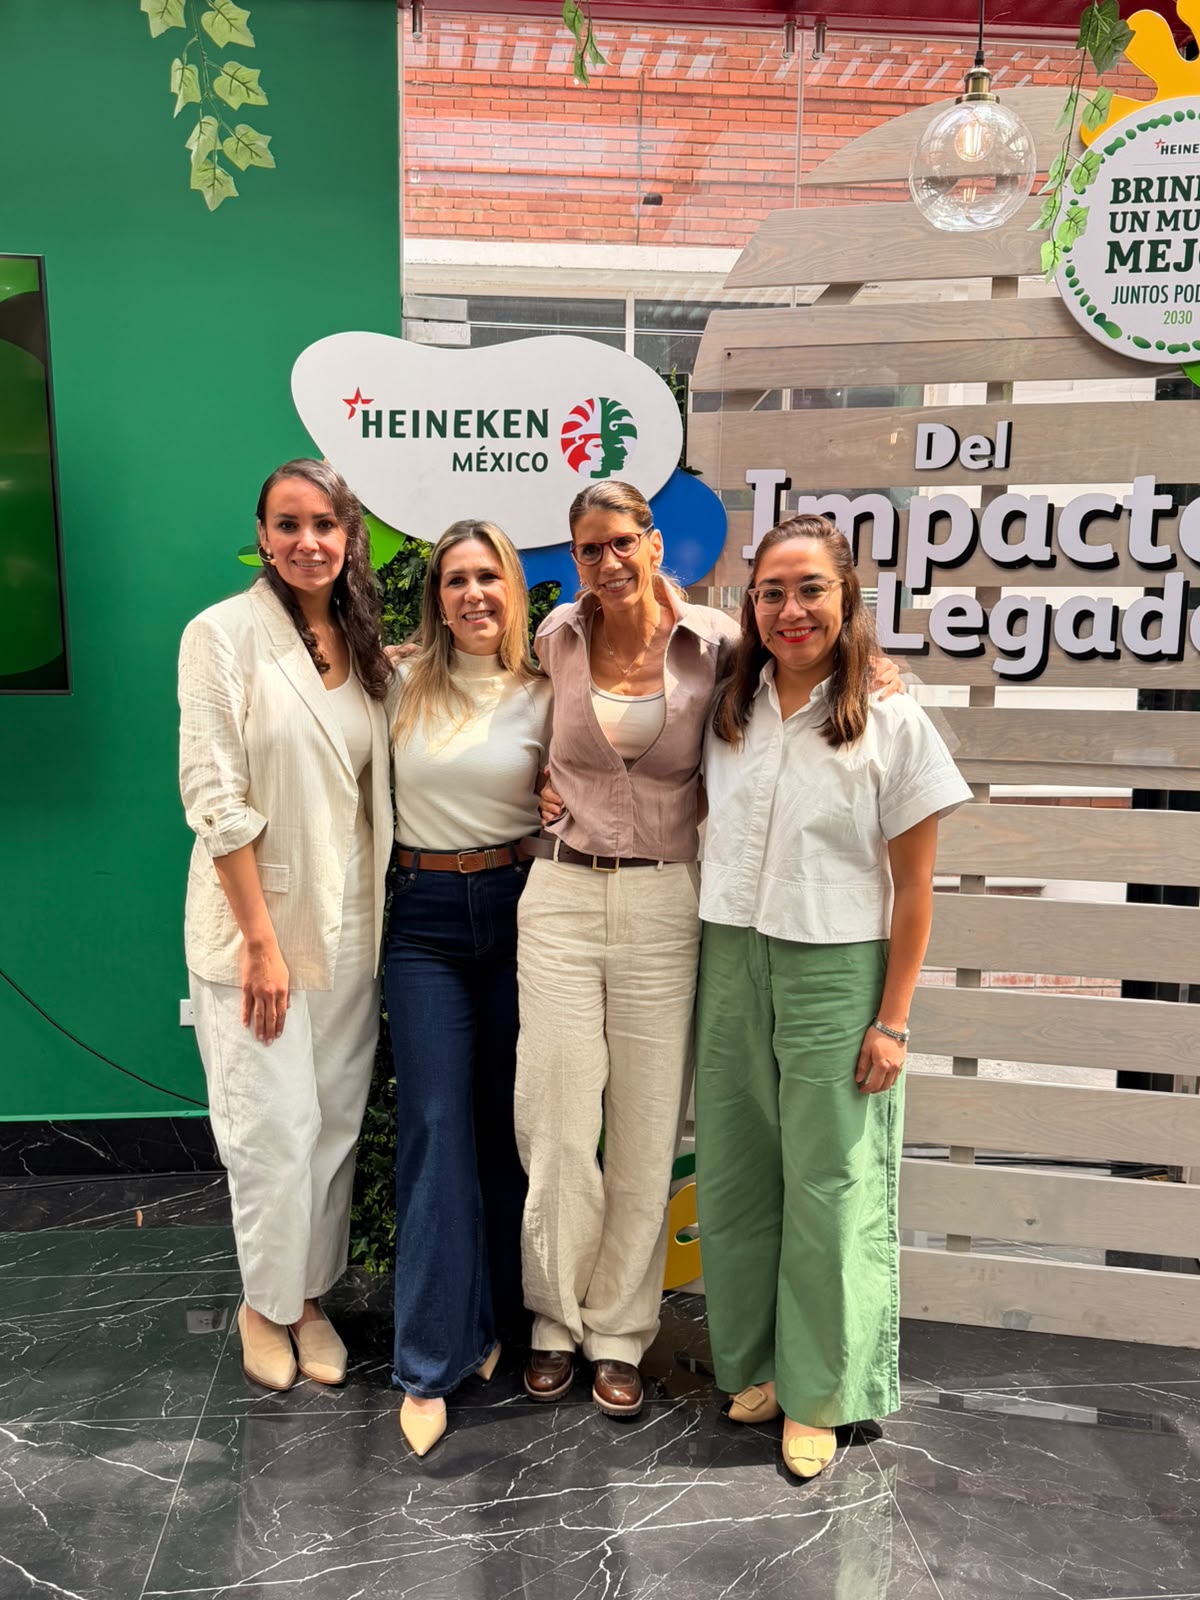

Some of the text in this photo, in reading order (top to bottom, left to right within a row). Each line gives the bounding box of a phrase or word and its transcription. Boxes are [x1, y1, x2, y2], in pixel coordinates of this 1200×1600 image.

[1110, 175, 1200, 205] BRIN
[1109, 211, 1150, 233] UN
[1104, 238, 1200, 274] MEJ
[1111, 285, 1169, 304] JUNTOS
[1163, 310, 1193, 325] 2030
[361, 408, 549, 438] HEINEKEN
[452, 445, 549, 472] MÉXICO
[914, 421, 1011, 470] Del
[875, 572, 1200, 678] Legad
